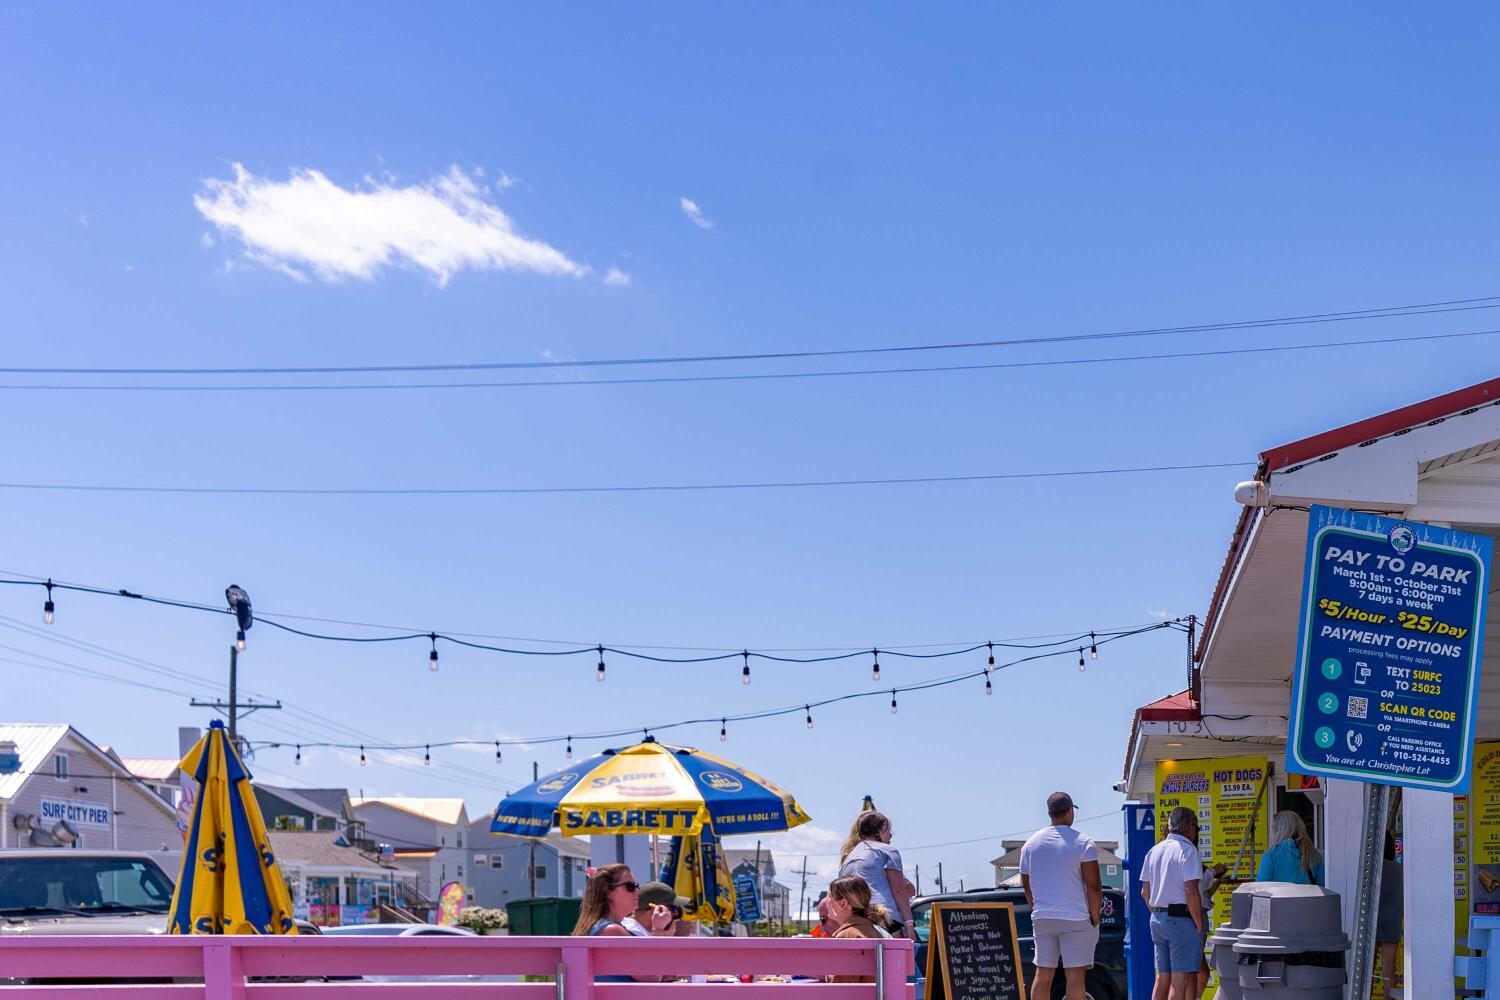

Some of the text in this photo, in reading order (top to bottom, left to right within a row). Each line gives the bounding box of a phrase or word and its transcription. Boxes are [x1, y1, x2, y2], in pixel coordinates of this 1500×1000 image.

[1324, 546, 1472, 584] PAY TO PARK
[1333, 566, 1367, 580] March
[1369, 570, 1385, 583] 1st
[1394, 576, 1439, 592] October
[1440, 584, 1462, 596] 31st
[1349, 579, 1392, 594] 9:00am
[1401, 587, 1445, 603] 6:00pm
[1358, 590, 1365, 599] 7
[1368, 591, 1394, 605] days
[1405, 600, 1434, 611] week
[1318, 598, 1468, 639] $5/Hour $25/Day
[1320, 625, 1462, 658] PAYMENT OPTIONS
[1348, 647, 1433, 666] processing fees may apply
[1386, 666, 1443, 683] TEXT SURFC
[1380, 690, 1395, 699] OR
[1395, 680, 1442, 695] TO 25023
[1324, 698, 1333, 709] 2
[1380, 702, 1457, 722] SCAN QR CODE
[1377, 723, 1392, 733] OR
[1383, 714, 1451, 730] VIA SMARTPHONE CAMERA
[1321, 732, 1329, 743] 3
[1387, 735, 1401, 743] CALL
[1424, 740, 1443, 748] OFFICE
[1389, 742, 1400, 750] YOU
[1415, 746, 1445, 756] ASSISTANCE
[1325, 753, 1431, 775] You are at Christopher Lot
[1393, 751, 1451, 766] 910-524-4455
[1477, 752, 1494, 769] COLD
[1214, 769, 1233, 782] HOT
[1236, 768, 1263, 781] DOGS
[1223, 784, 1241, 792] $3.99
[1159, 799, 1180, 807] PLAIN
[42, 801, 108, 824] SURF CITY PIER
[566, 808, 697, 830] SABRETT
[950, 911, 989, 922] Attention
[967, 954, 973, 963] 2
